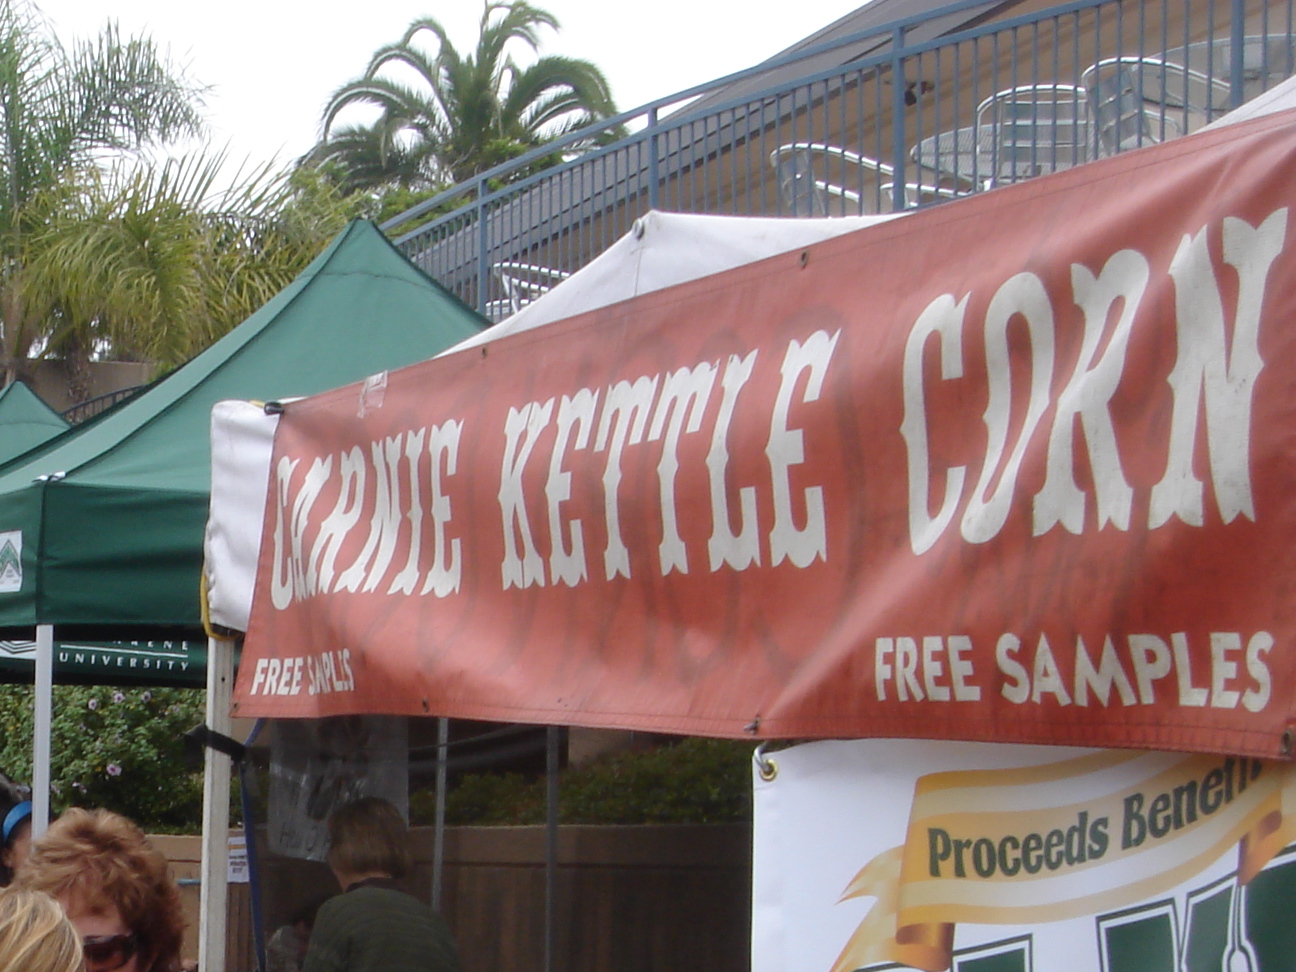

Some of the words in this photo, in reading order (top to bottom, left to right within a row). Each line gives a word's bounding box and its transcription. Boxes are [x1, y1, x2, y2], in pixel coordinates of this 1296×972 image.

[271, 418, 464, 610] CARNIE
[498, 327, 841, 590] KETTLE
[899, 206, 1288, 556] CORN
[59, 652, 189, 671] UNIVERSITY
[250, 657, 303, 695] FREE
[875, 635, 981, 702] FREE
[996, 631, 1274, 713] SAMPLES
[927, 811, 1109, 878] Proceeds
